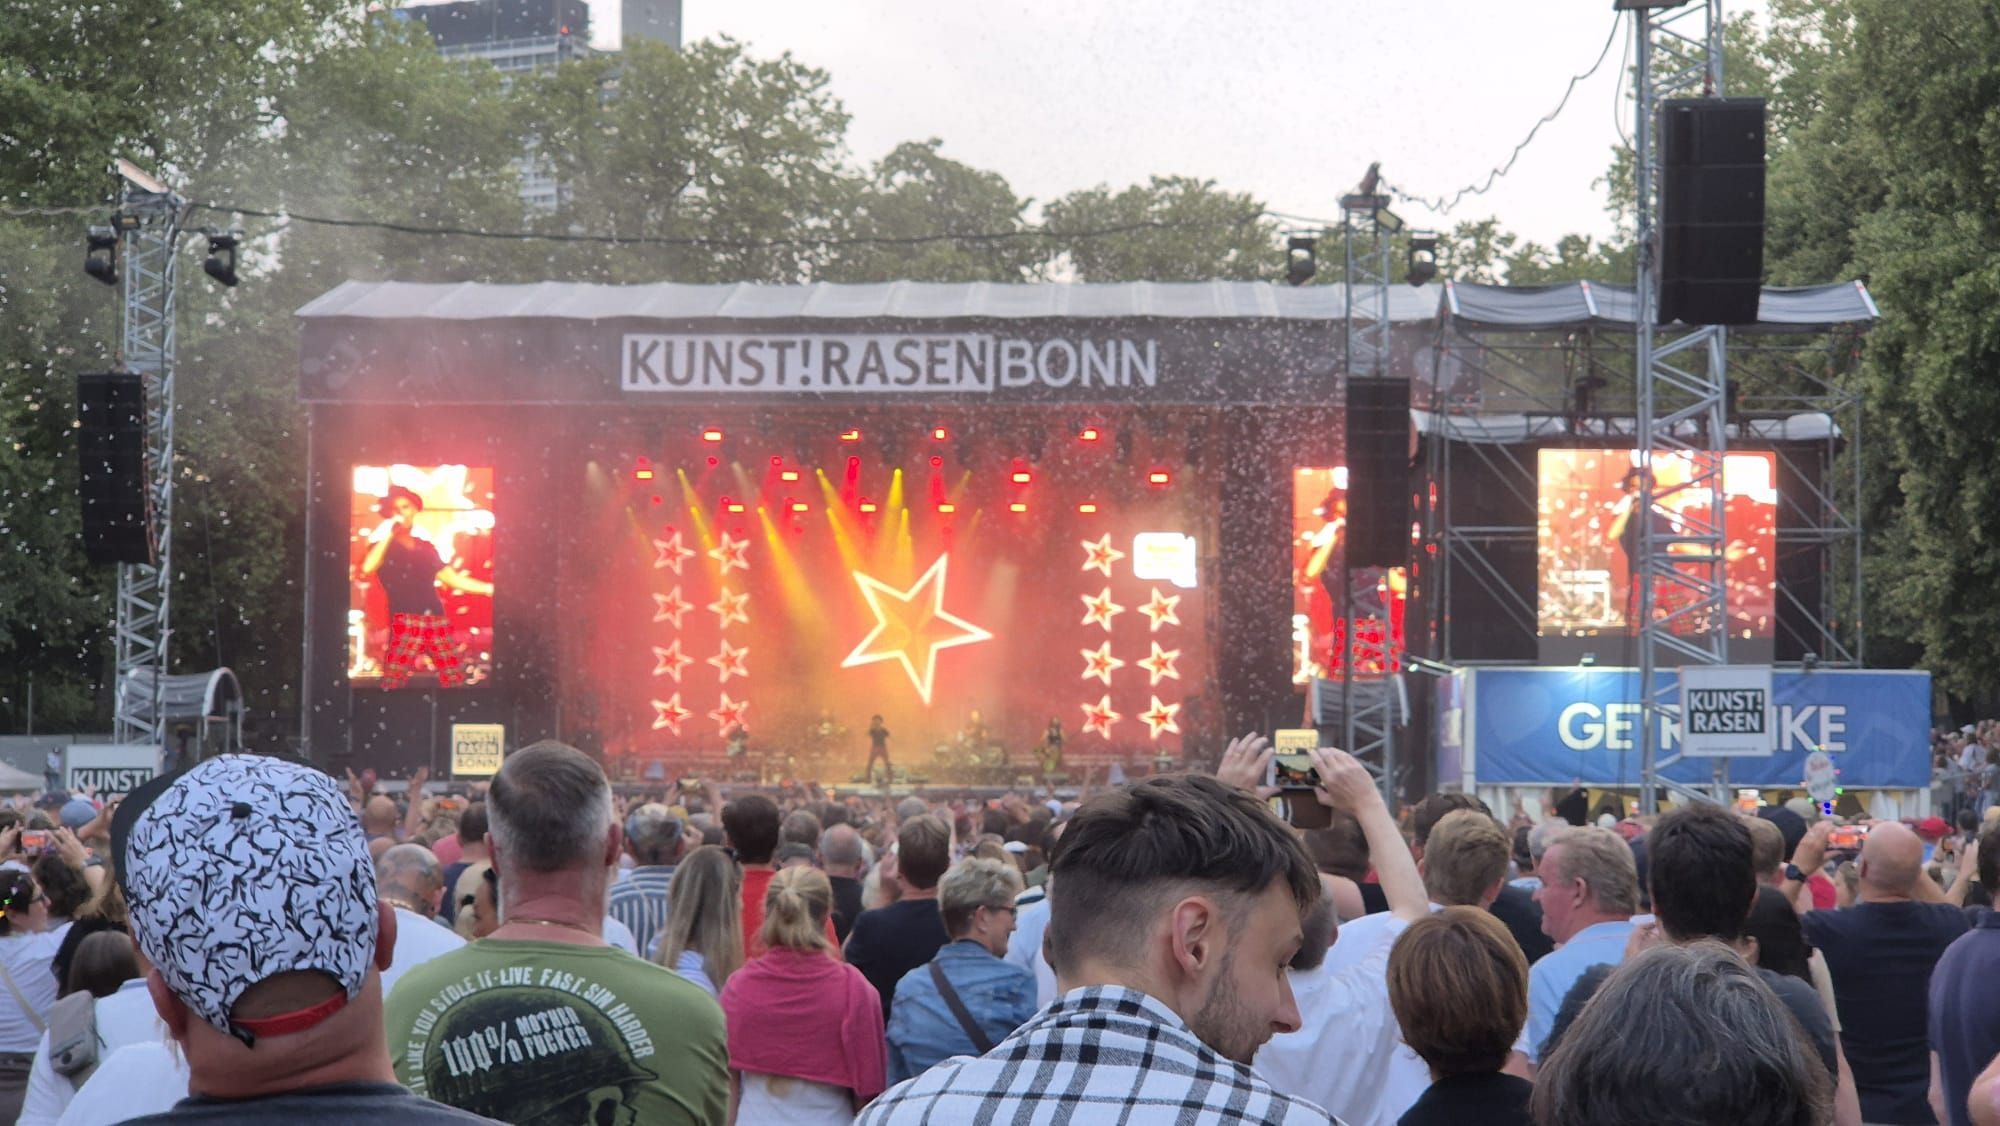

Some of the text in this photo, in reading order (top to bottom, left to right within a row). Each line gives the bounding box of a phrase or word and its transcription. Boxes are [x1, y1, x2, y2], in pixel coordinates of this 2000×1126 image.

[1001, 339, 1157, 387] BONN
[1689, 690, 1763, 711] KUNST!
[1693, 711, 1760, 733] RASEN
[499, 966, 534, 986] LIVE
[430, 976, 477, 1013] STOLE
[583, 983, 617, 1009] SIN
[411, 1009, 438, 1036] YOU
[515, 1005, 581, 1037] MOTHER
[606, 1002, 655, 1059] HARDER
[407, 1040, 426, 1070] LIKE
[441, 1021, 524, 1077] 100%
[523, 1025, 592, 1060] FUCKER
